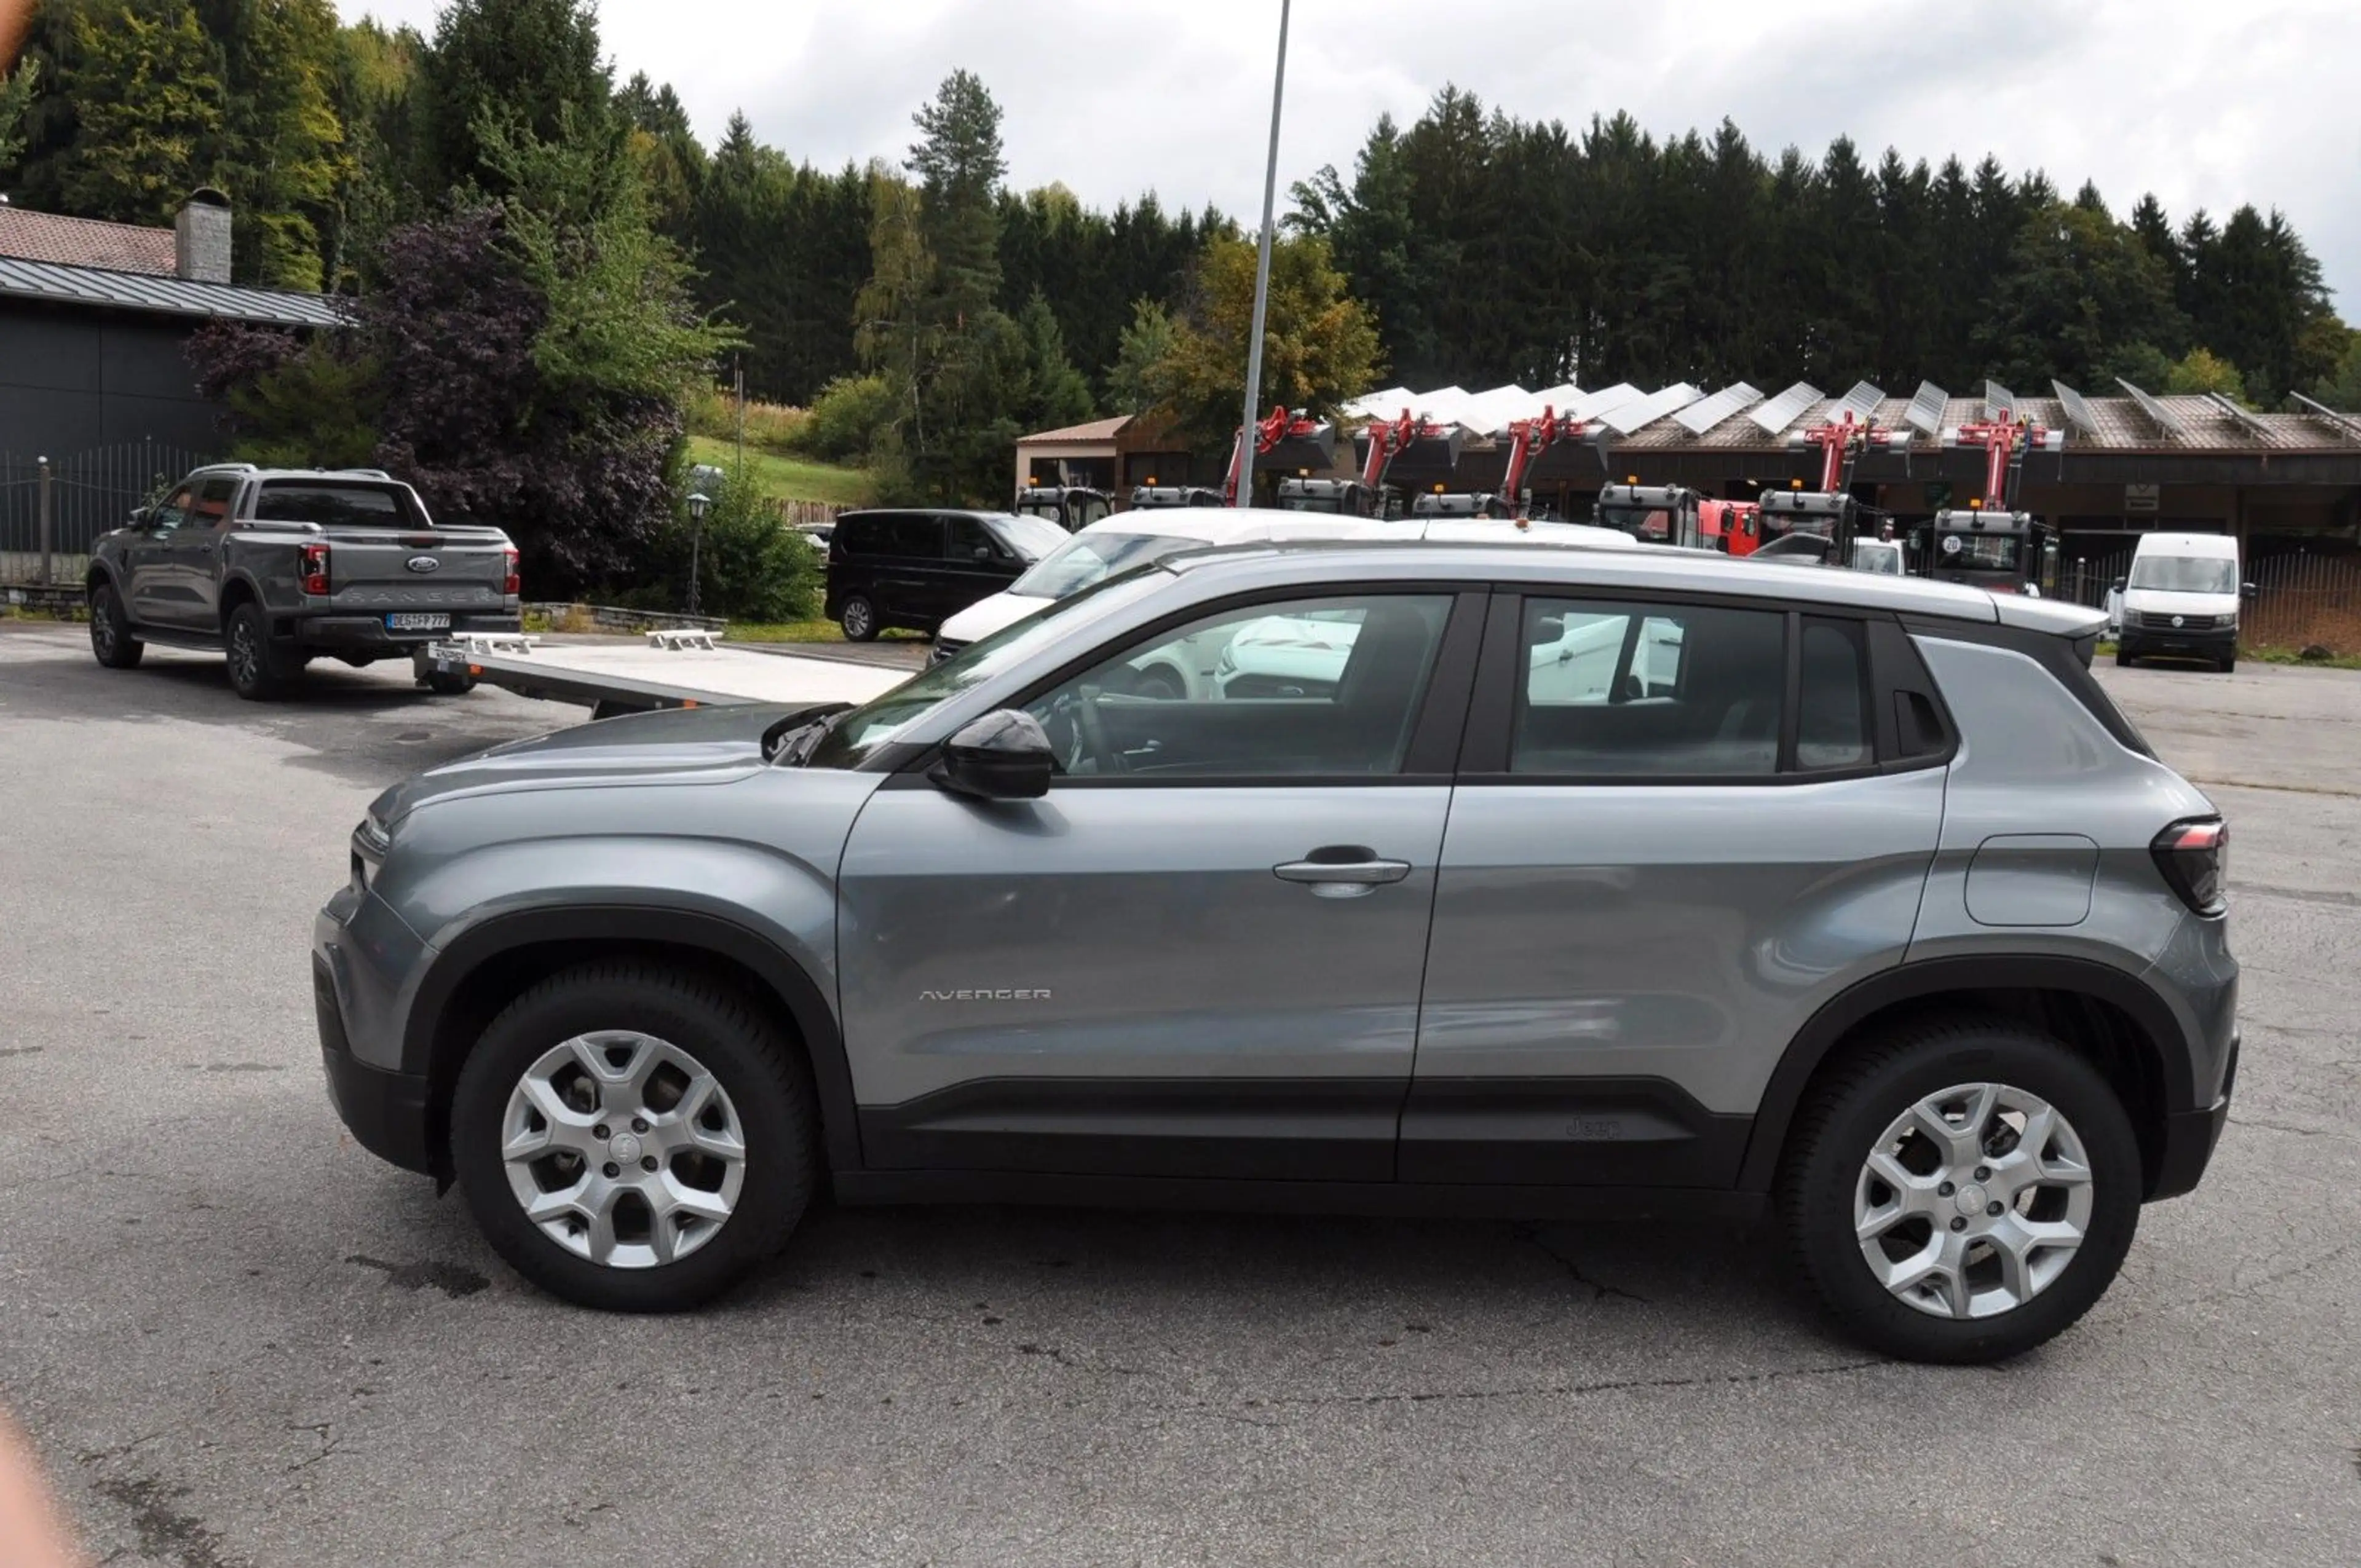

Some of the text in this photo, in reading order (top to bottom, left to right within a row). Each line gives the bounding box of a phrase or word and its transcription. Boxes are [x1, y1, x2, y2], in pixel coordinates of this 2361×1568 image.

[1946, 539, 1958, 551] 20
[919, 989, 1051, 1001] AVENGER
[1566, 1116, 1620, 1140] Jeep
